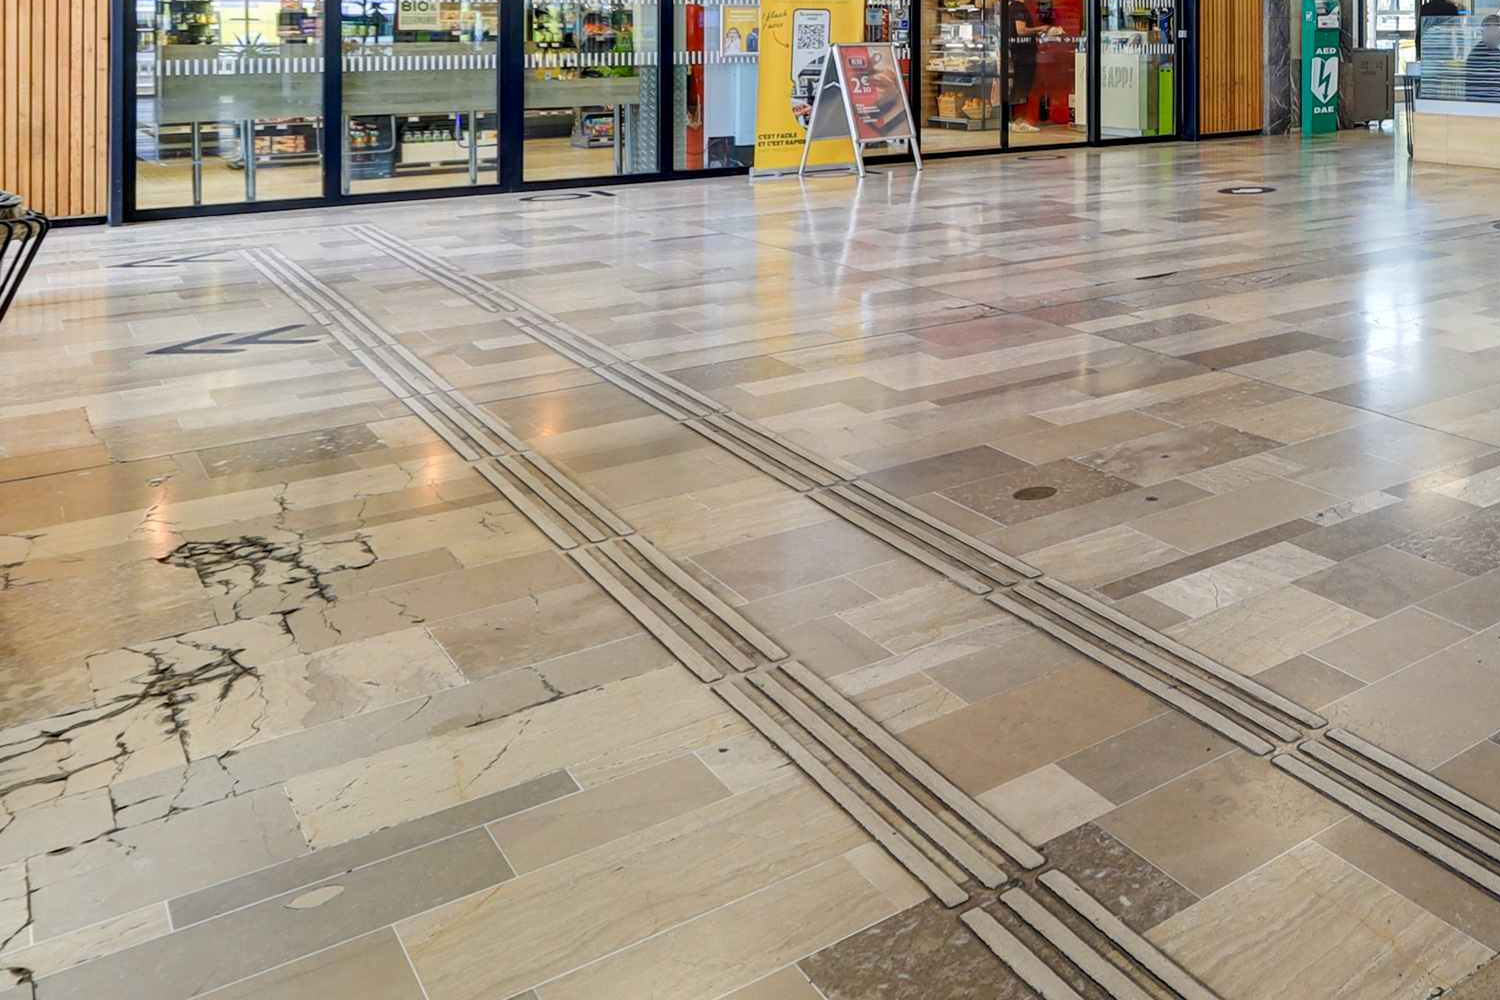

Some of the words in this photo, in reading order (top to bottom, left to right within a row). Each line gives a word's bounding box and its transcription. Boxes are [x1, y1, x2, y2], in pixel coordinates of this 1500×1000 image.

[401, 1, 429, 12] BIO
[1315, 47, 1337, 55] AED
[1108, 66, 1134, 89] APP!
[1313, 106, 1335, 114] DAE
